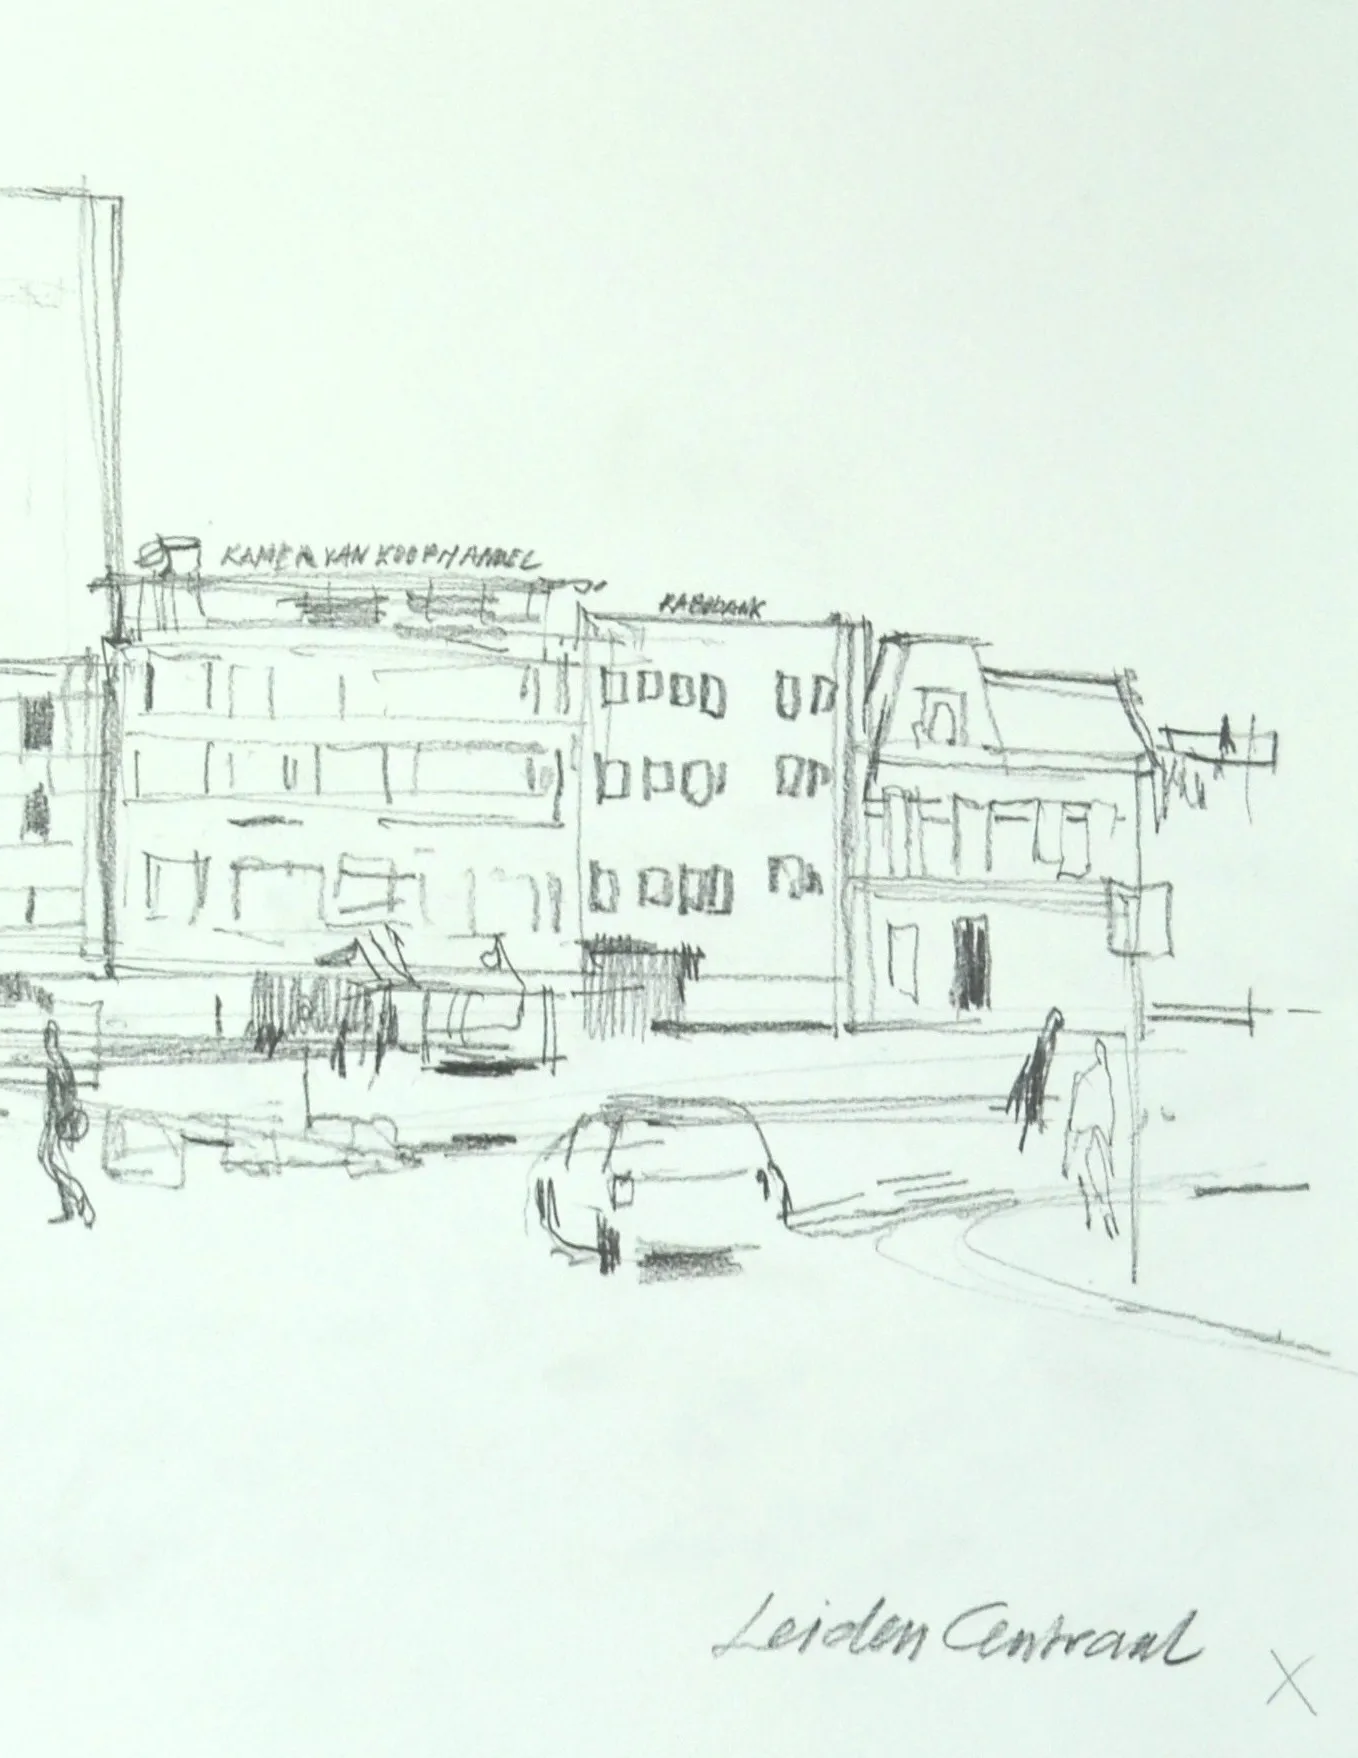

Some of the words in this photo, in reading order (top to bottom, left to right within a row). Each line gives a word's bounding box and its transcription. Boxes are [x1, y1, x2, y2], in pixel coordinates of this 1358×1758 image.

[324, 542, 370, 568] VAN
[711, 1592, 930, 1661] Leiden
[942, 1601, 1206, 1666] Centraal
